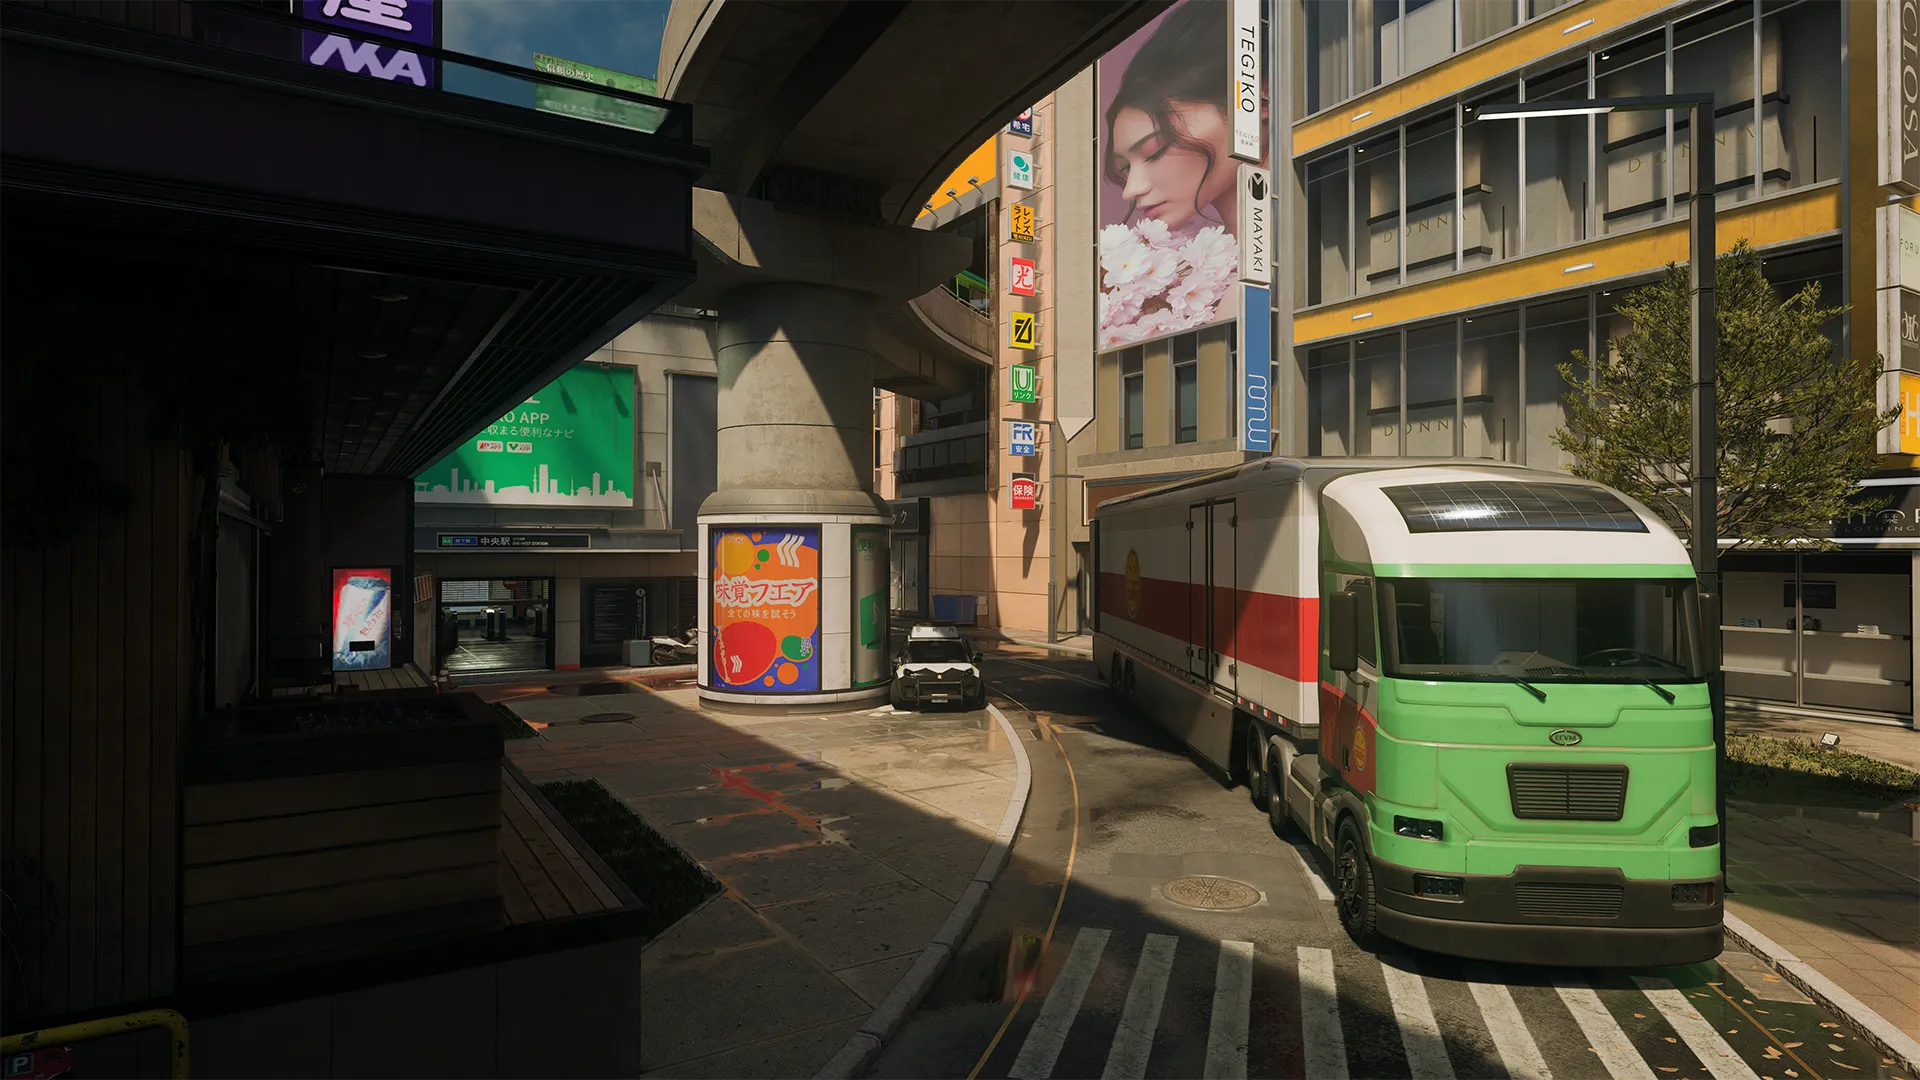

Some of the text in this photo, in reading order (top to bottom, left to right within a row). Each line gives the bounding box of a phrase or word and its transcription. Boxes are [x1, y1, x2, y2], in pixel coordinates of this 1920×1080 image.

[1241, 26, 1256, 113] TEGIKO
[1903, 0, 1919, 164] CLOSA
[1013, 206, 1022, 233] ライト
[1023, 207, 1031, 235] レンズ
[1383, 212, 1467, 243] DNN
[1253, 207, 1264, 272] MAYAKI
[1014, 266, 1032, 289] 光
[1014, 392, 1031, 400] リンク
[519, 412, 550, 425] APP
[1384, 418, 1467, 437] DNN
[481, 425, 575, 439] 収まる便利なナビ
[1013, 423, 1033, 441] FR
[1015, 445, 1030, 454] 安全
[1012, 484, 1034, 496] 保険
[480, 536, 511, 546] 中央駅
[727, 609, 797, 620] 全ての味を試そう
[12, 1056, 29, 1073] P
